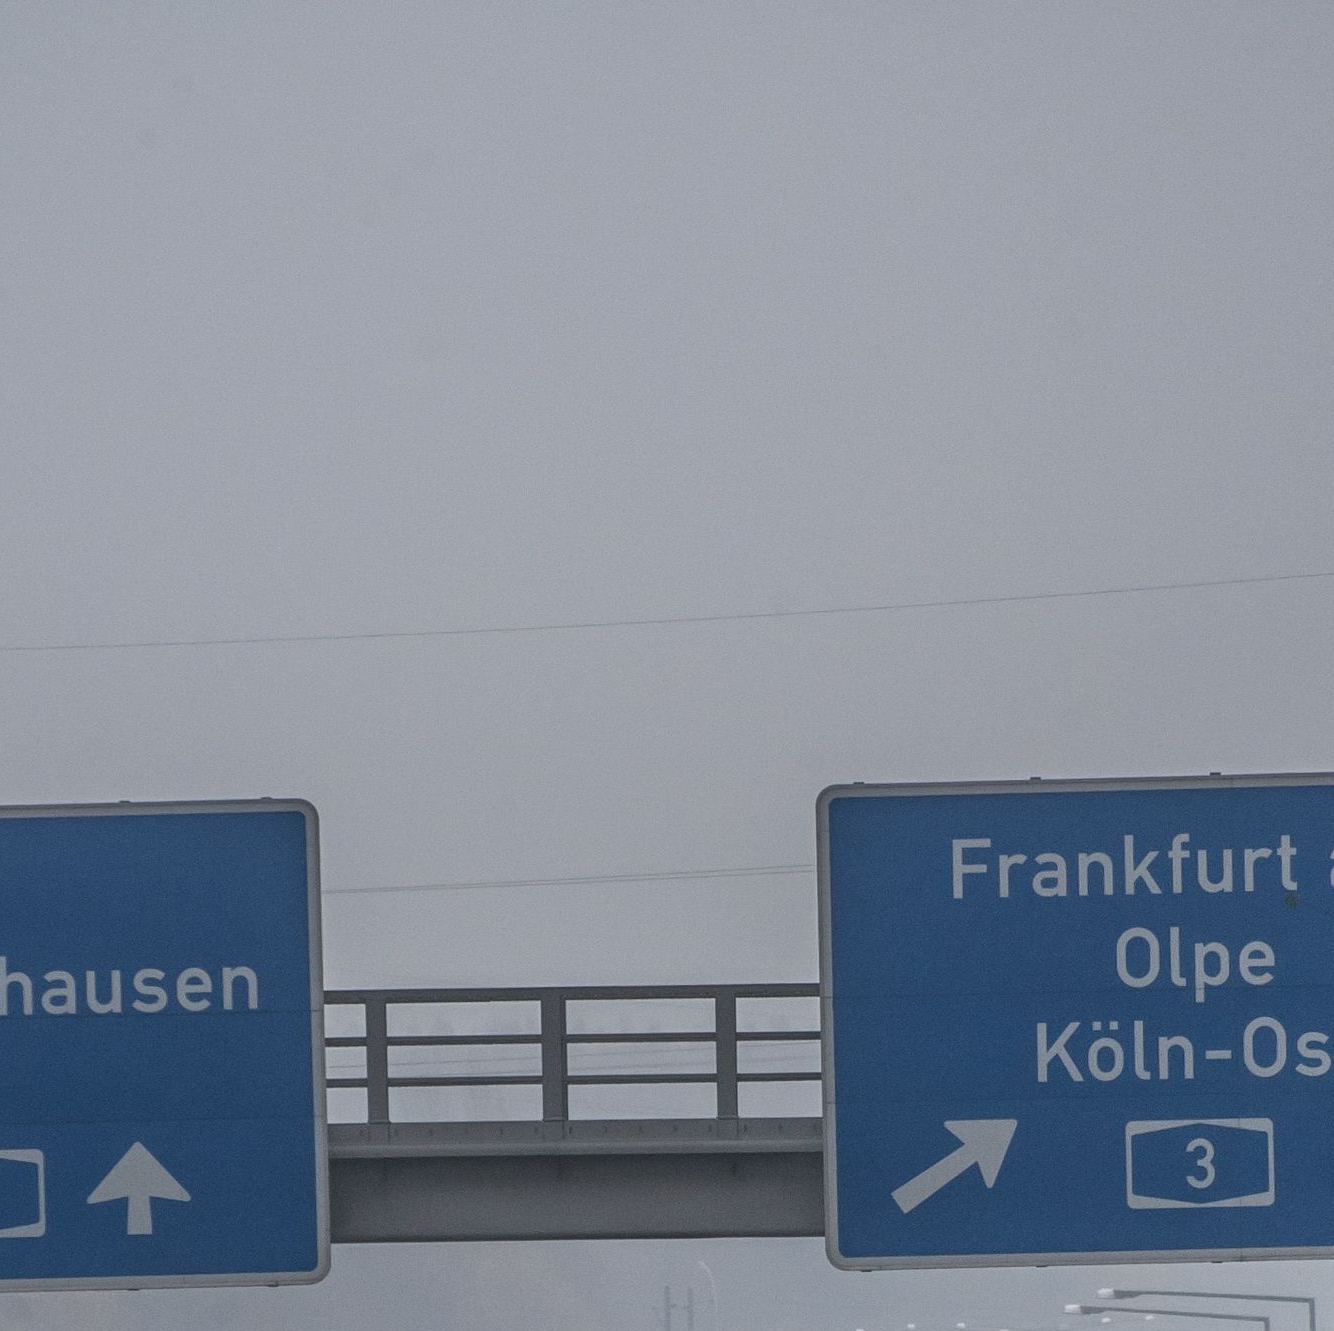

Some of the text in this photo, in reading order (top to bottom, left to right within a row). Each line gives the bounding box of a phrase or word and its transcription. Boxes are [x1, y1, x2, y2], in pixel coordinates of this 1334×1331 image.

[952, 832, 1298, 899] Frankfurt
[1116, 926, 1276, 1002] Olpe
[1185, 1137, 1216, 1189] 3
